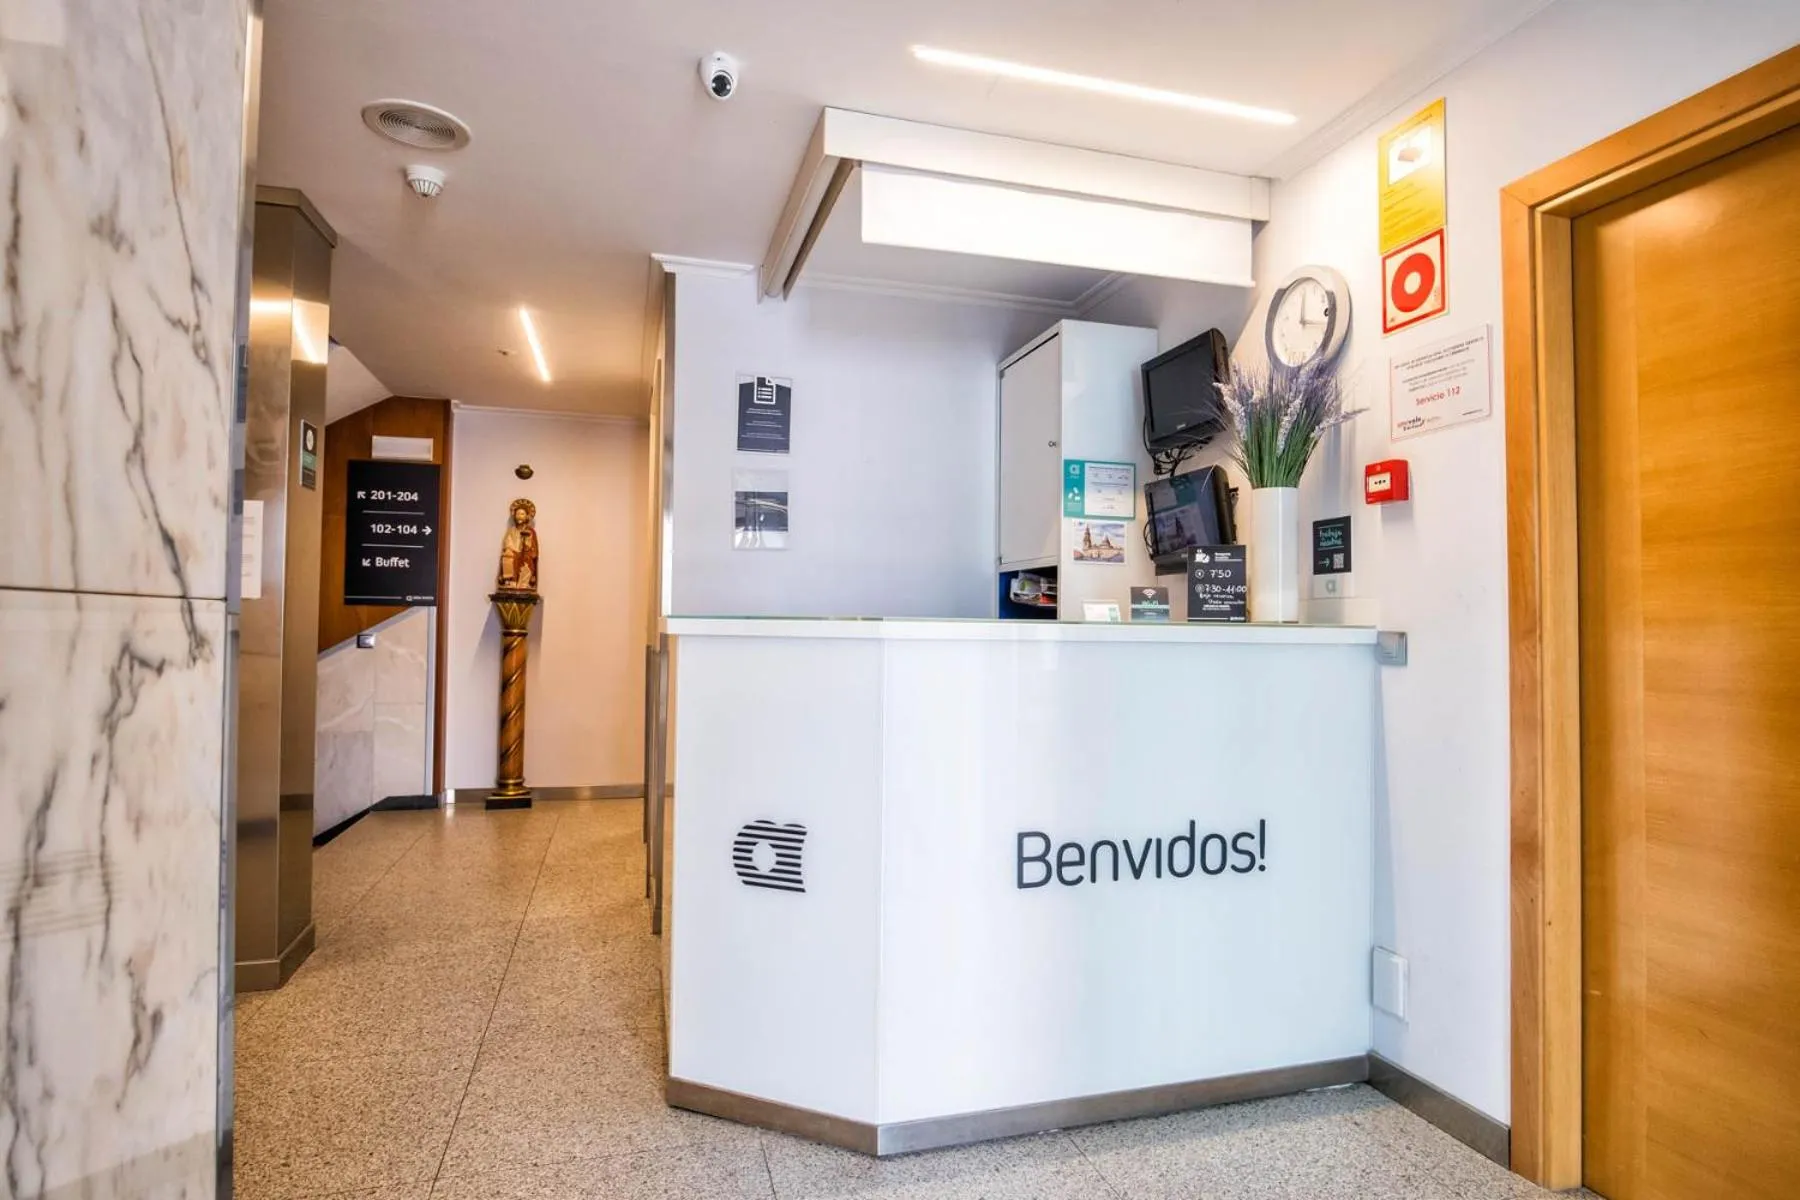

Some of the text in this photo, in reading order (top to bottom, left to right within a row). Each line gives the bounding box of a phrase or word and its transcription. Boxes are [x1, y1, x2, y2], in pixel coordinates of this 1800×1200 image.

[1416, 385, 1461, 406] Servicio 112
[370, 490, 419, 502] 201-204
[370, 523, 417, 535] 102-104
[375, 556, 411, 568] Buffet
[1016, 818, 1267, 890] Benvidos!
